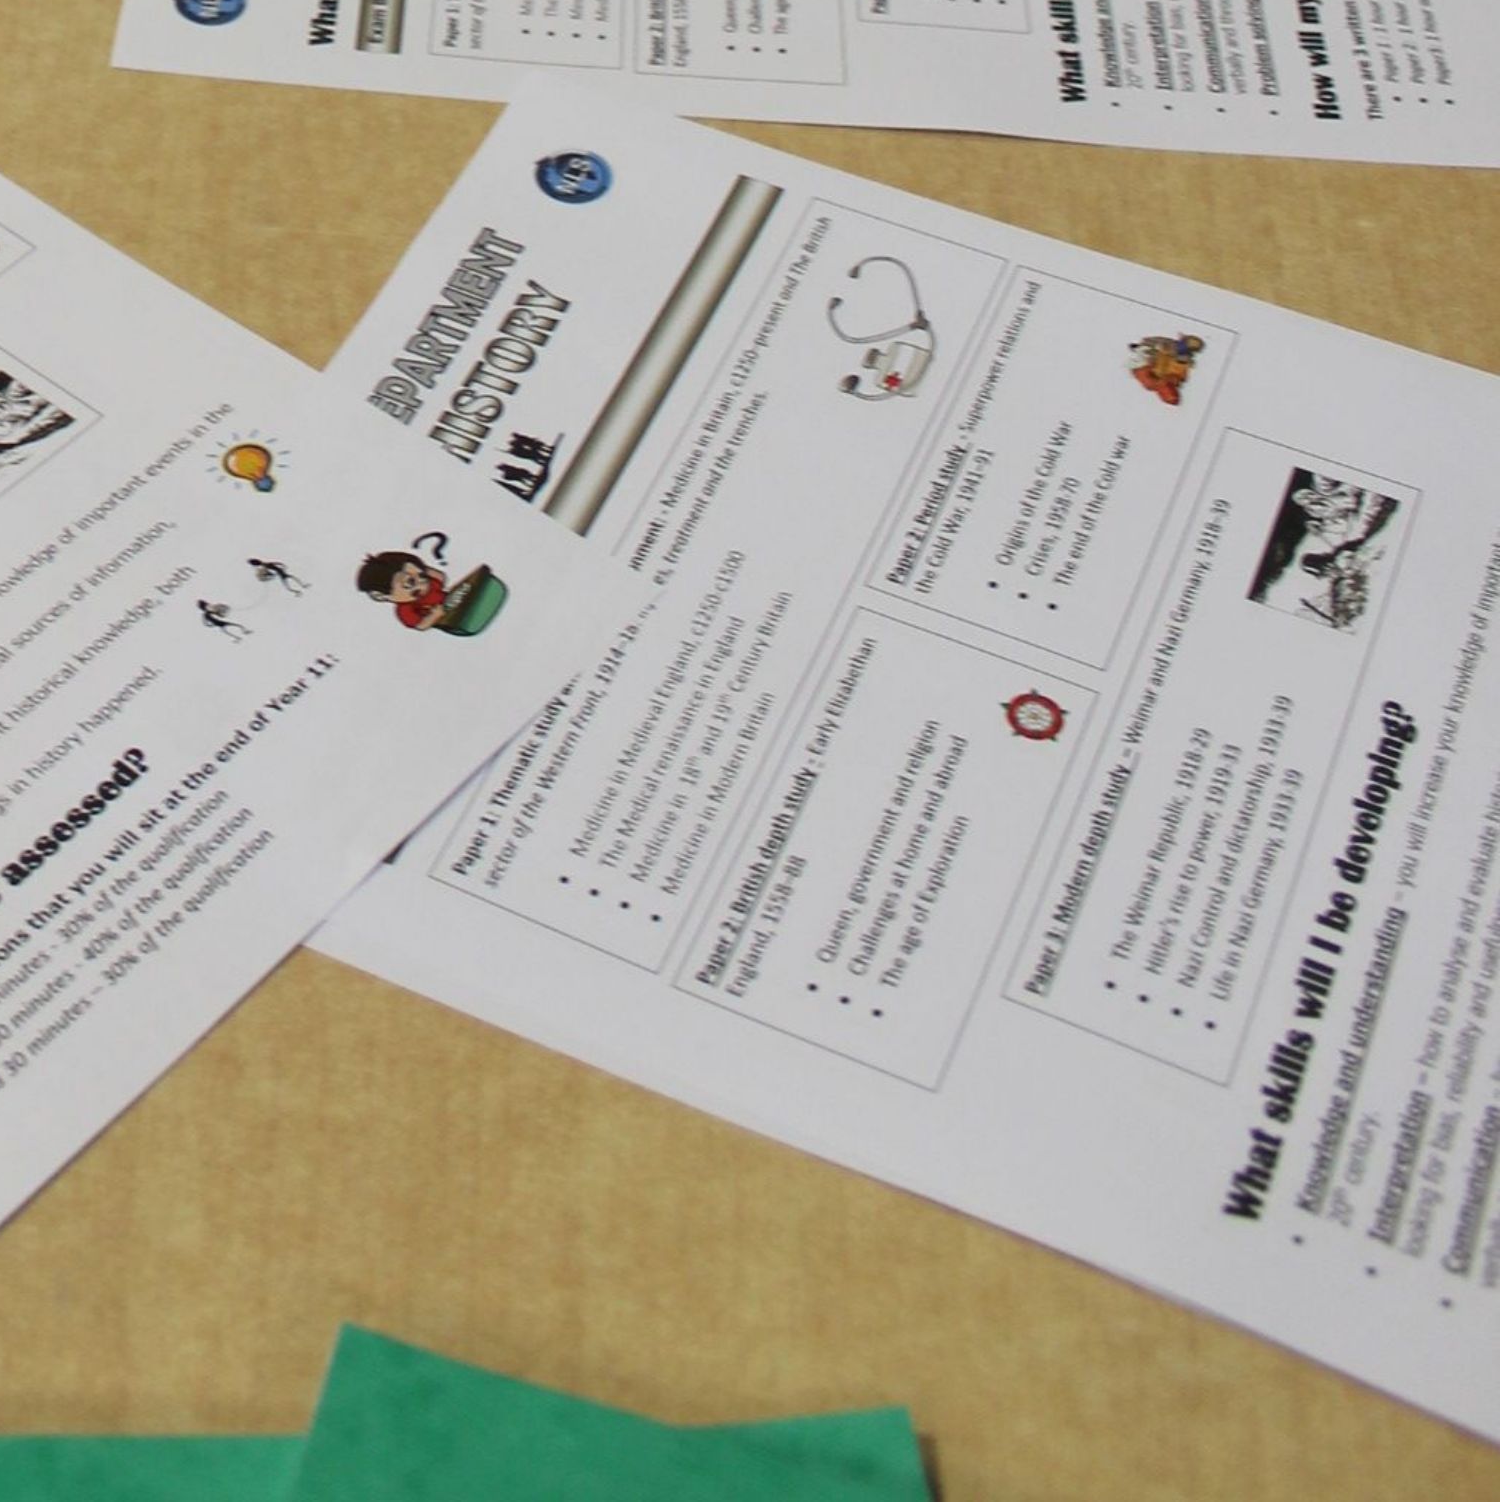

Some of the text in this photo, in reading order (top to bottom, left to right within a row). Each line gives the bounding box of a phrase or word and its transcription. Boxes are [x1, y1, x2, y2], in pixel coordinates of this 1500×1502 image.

[366, 7, 387, 44] Exam
[1055, 49, 1087, 103] What
[1297, 30, 1330, 67] will
[1312, 73, 1342, 120] How
[554, 156, 592, 195] NLS
[367, 227, 525, 425] EPARTMENT
[885, 444, 967, 586] Paper 2: Period study
[994, 420, 1072, 566] Origins of the Cold War
[1023, 476, 1082, 577] Crises, 1958-70
[1051, 435, 1131, 586] The end of the Cold war
[0, 747, 149, 887] assessed?
[24, 893, 72, 930] that
[66, 862, 107, 896] you
[102, 829, 141, 862] will
[138, 808, 167, 833] sit
[162, 789, 188, 811] at
[180, 762, 218, 791] the
[214, 729, 252, 763] end
[248, 710, 270, 732] of
[263, 678, 309, 712] Year
[305, 653, 339, 679] 11:
[1023, 763, 1133, 997] Paper 3: Modern depth study
[1222, 700, 1418, 1221] What skills will I be developing?
